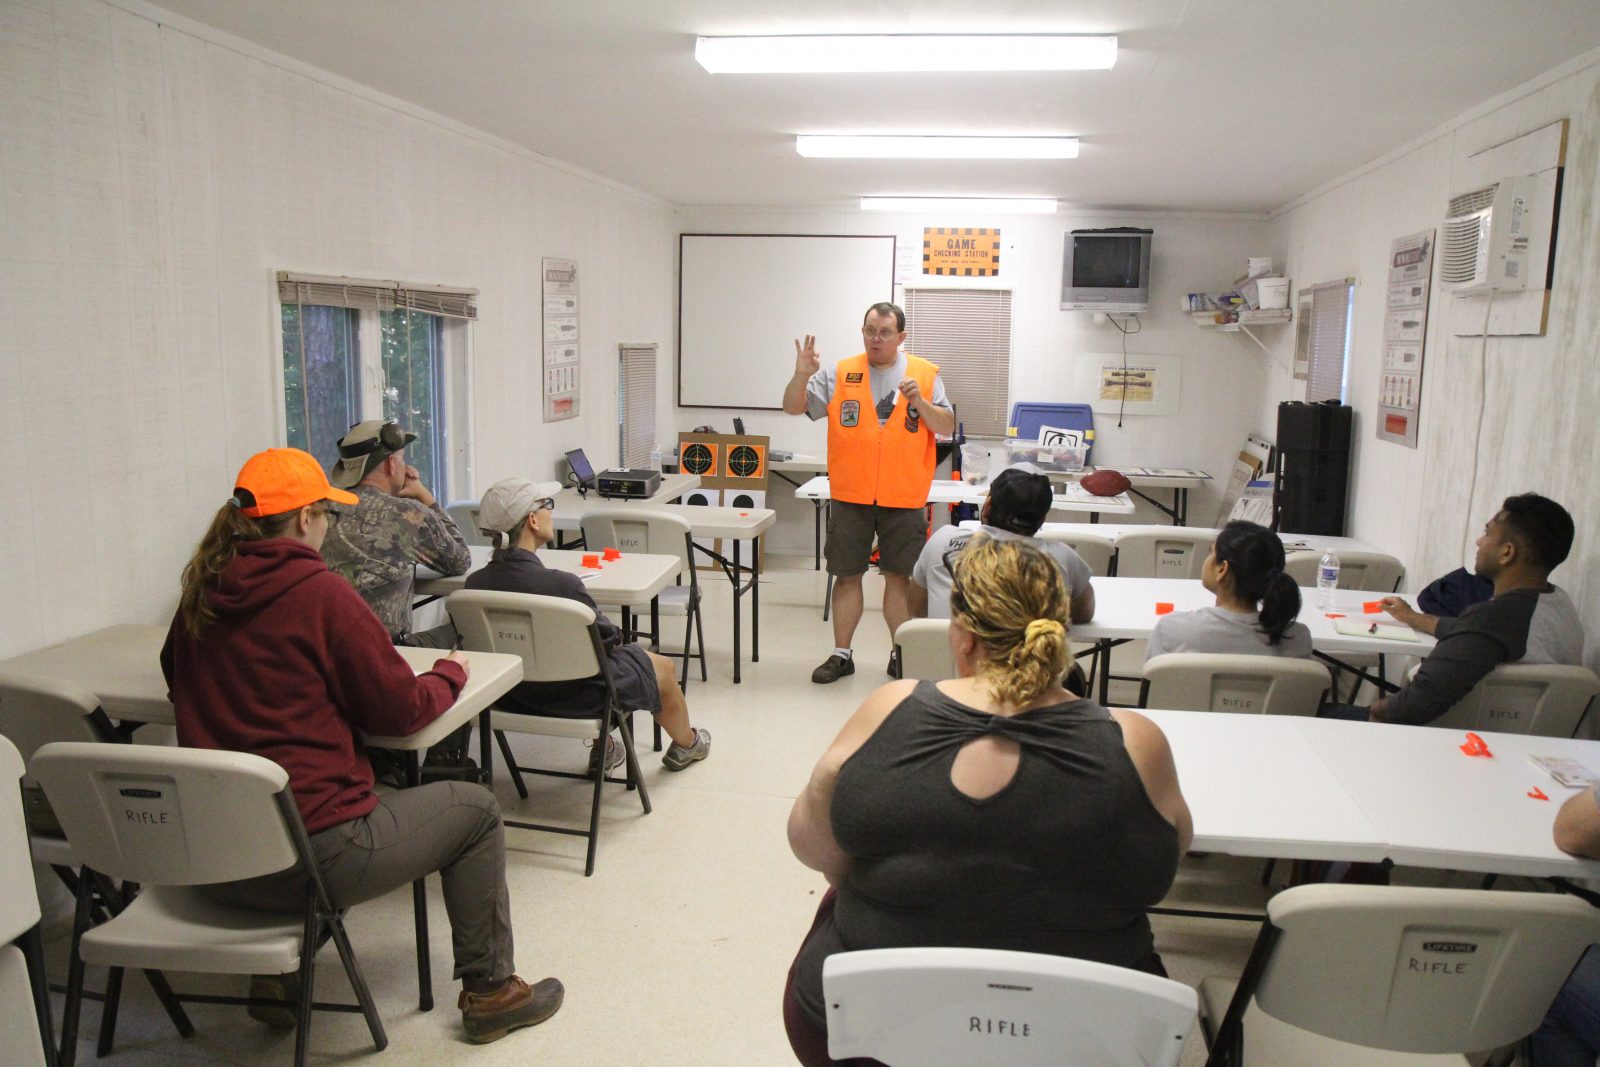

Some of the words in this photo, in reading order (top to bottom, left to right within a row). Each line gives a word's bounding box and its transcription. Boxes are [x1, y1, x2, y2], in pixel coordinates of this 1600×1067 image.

[947, 239, 976, 249] GAME
[620, 539, 640, 547] RIFLE
[498, 631, 527, 641] RIFLE
[1223, 698, 1252, 708] RIFLE
[1489, 710, 1520, 720] RIFLE
[125, 810, 168, 825] RIFLE
[1426, 943, 1473, 952] LIFETIME
[1409, 958, 1468, 974] RIFLE
[969, 1016, 1031, 1037] RIFLE
